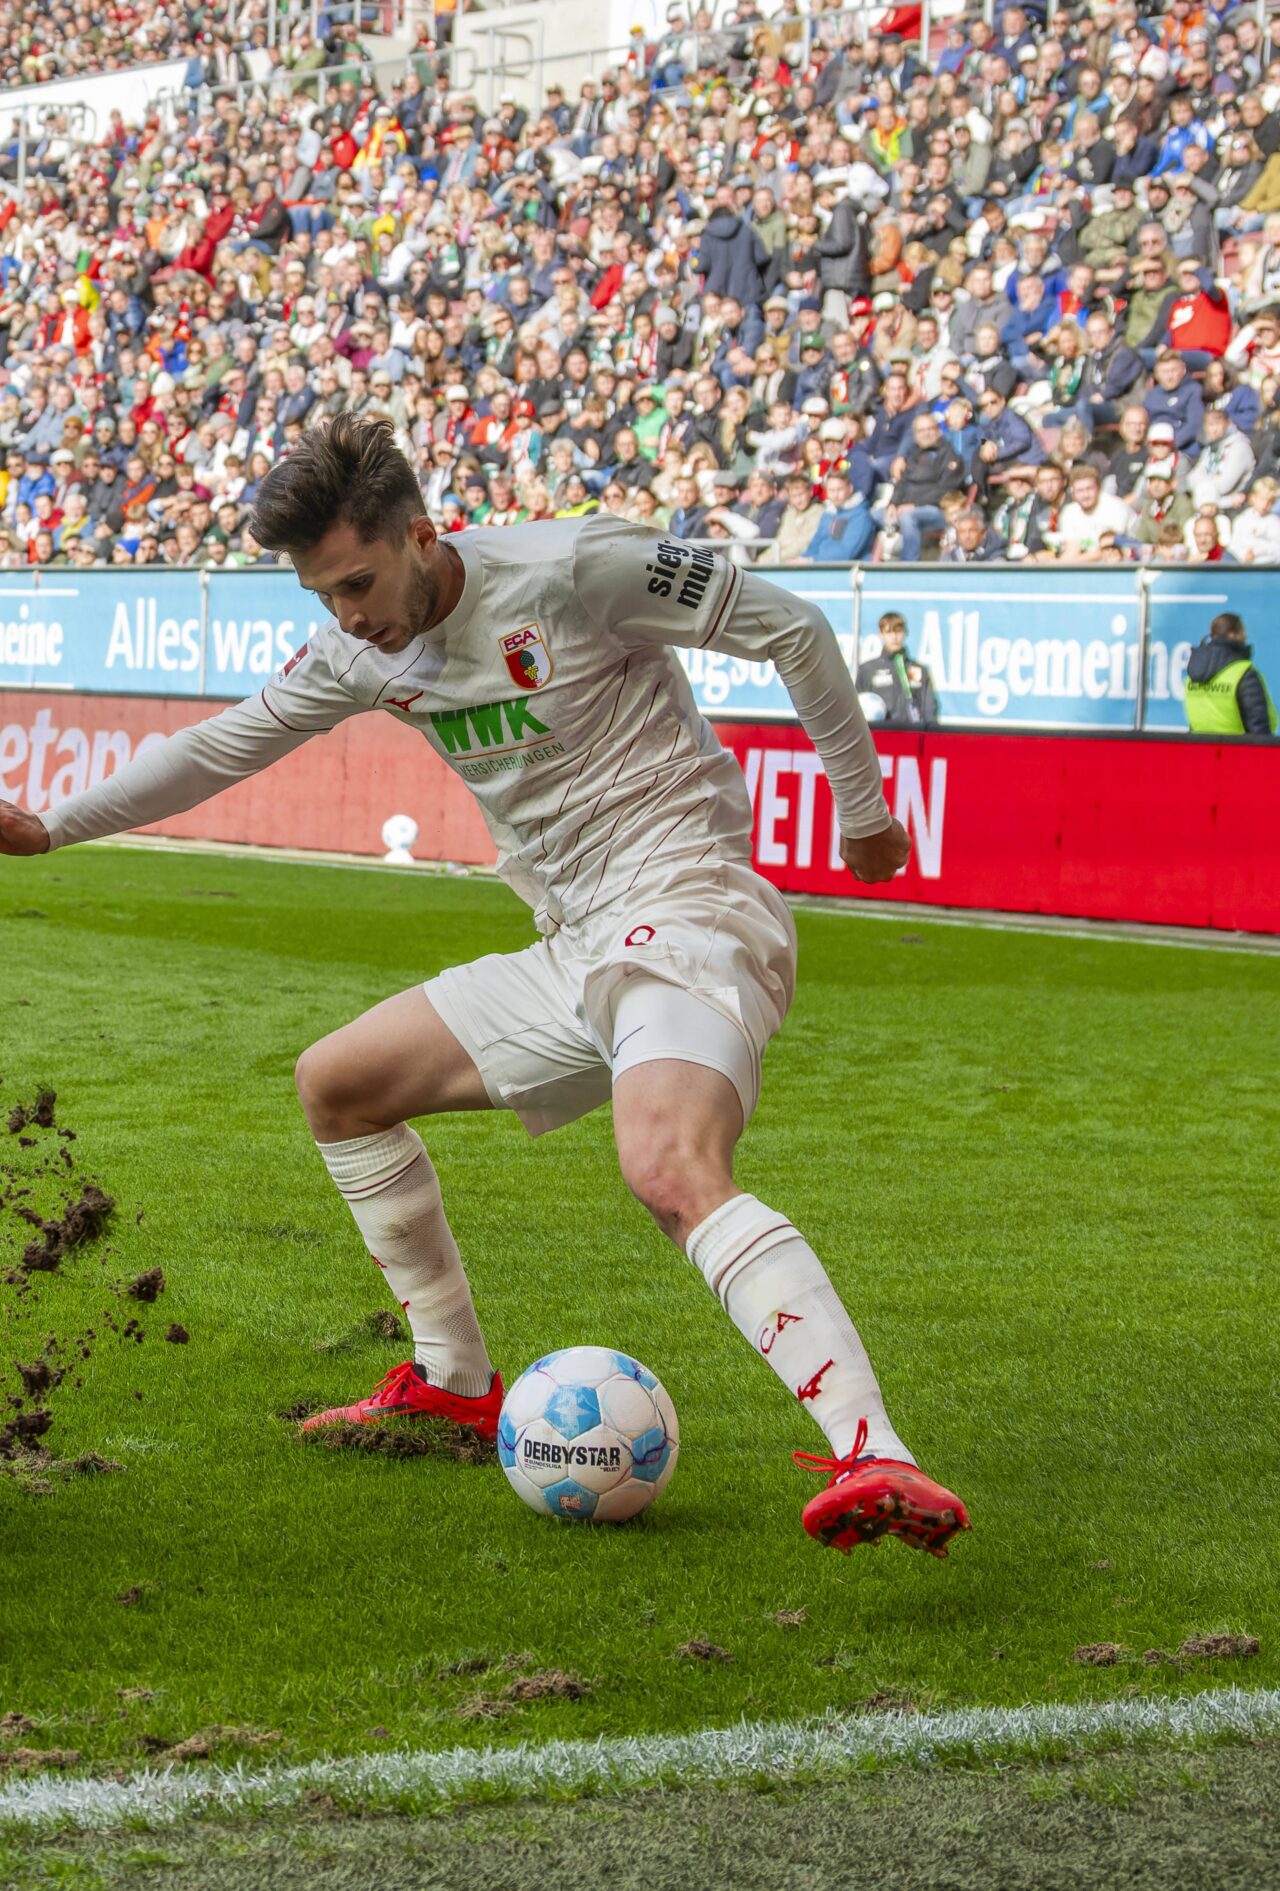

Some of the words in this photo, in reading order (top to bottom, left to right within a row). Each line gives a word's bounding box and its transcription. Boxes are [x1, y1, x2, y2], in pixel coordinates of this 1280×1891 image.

[105, 597, 200, 672] Alles
[213, 620, 296, 674] was
[429, 696, 552, 753] WWK
[459, 742, 566, 777] VERSICHERUNGEN
[524, 1439, 621, 1466] DERBYSTAR
